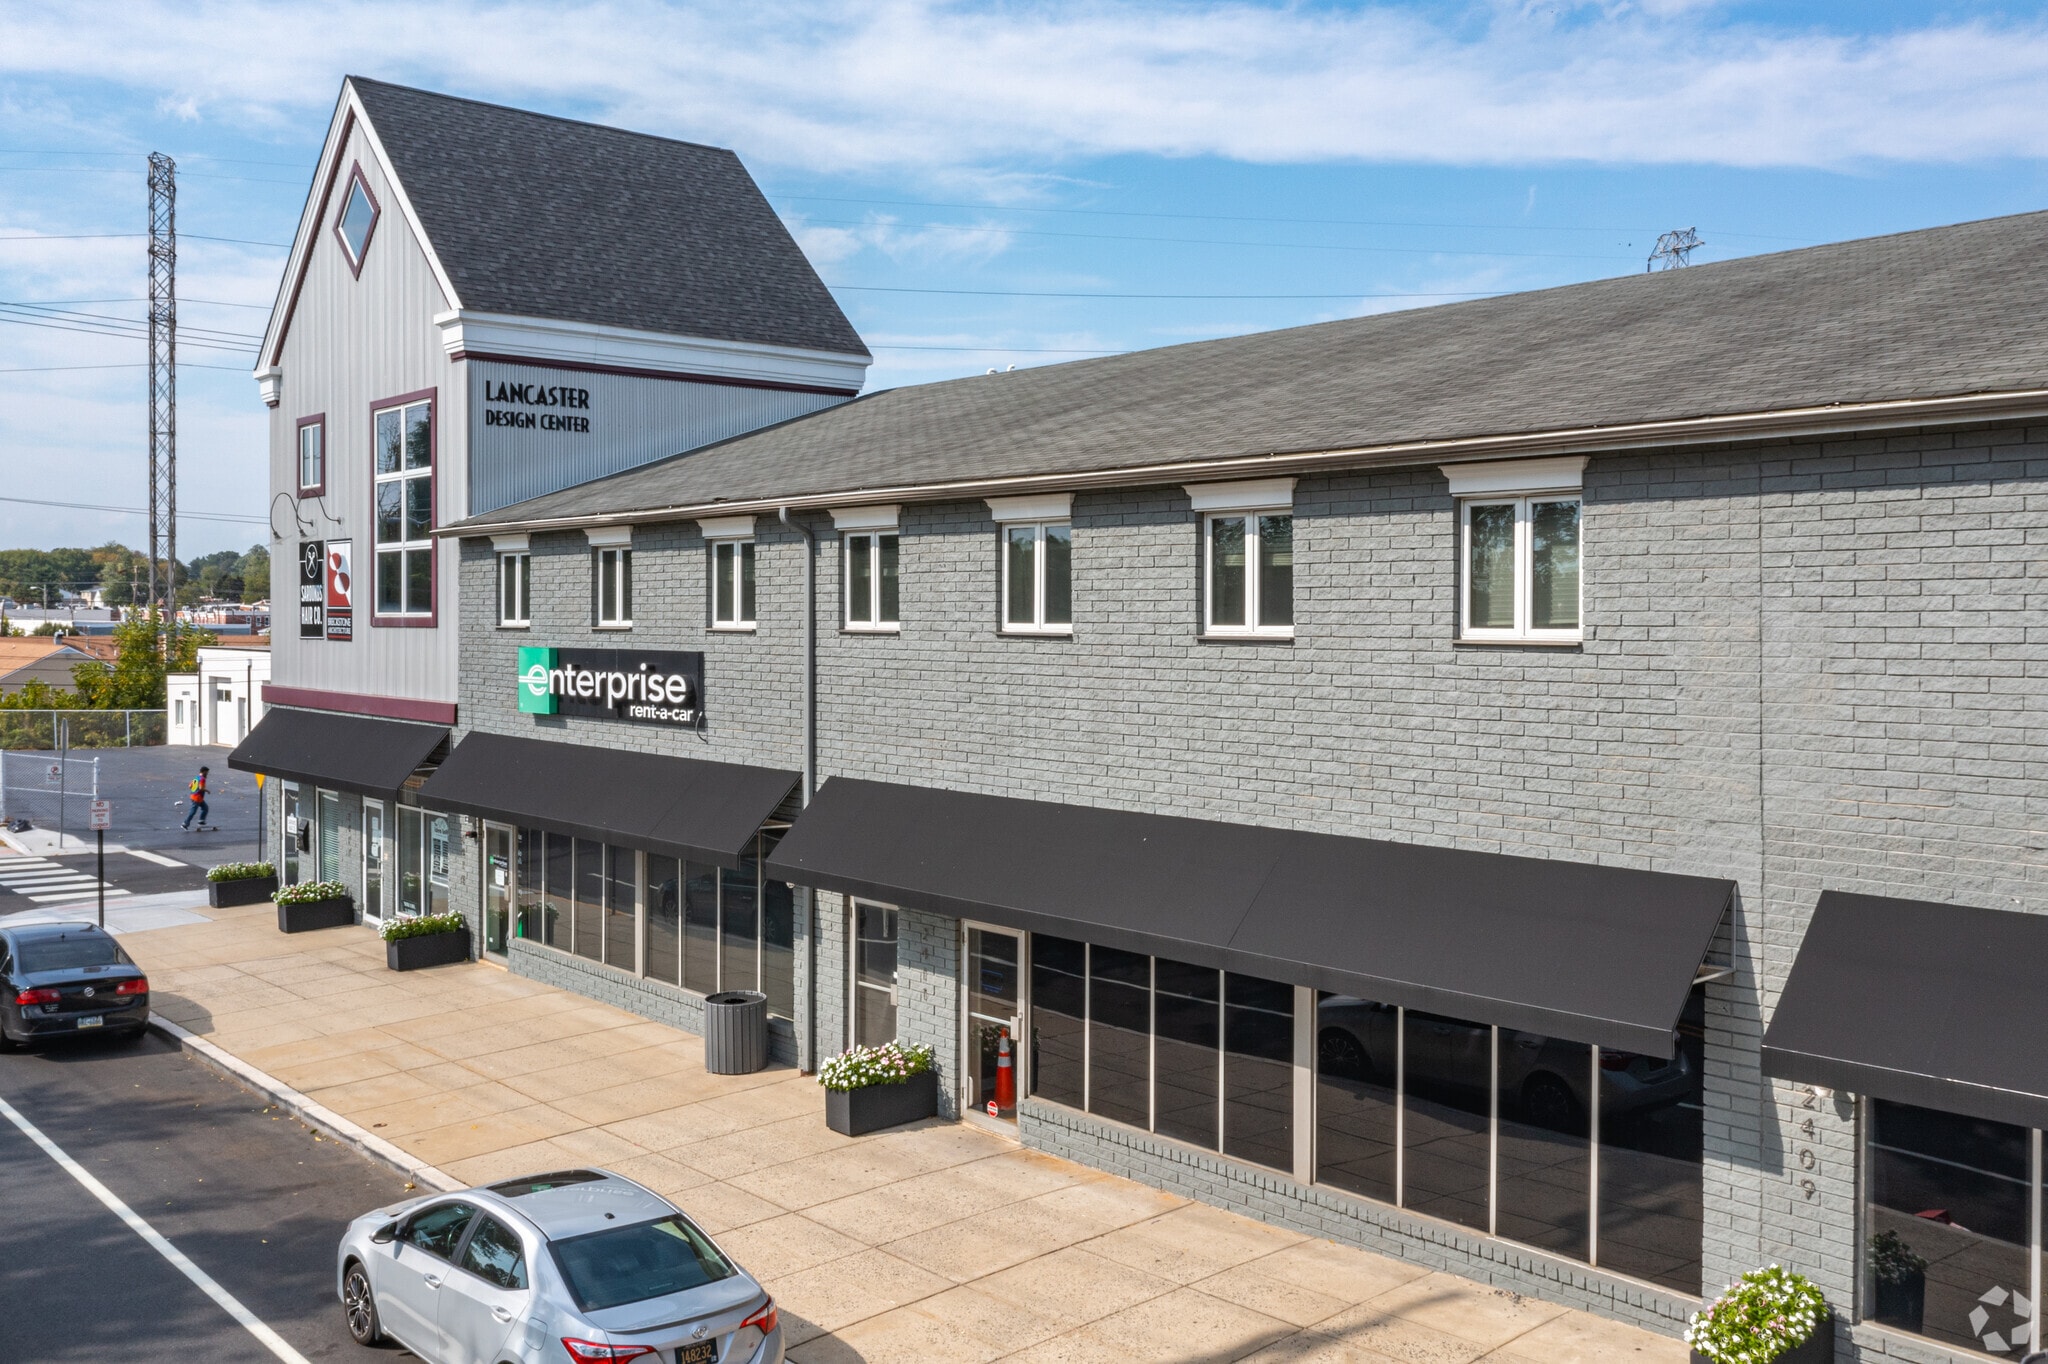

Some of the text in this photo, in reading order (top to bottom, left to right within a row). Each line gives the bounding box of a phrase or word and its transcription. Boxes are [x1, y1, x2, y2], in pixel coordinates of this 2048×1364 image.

[486, 380, 589, 409] LANCASTER
[486, 409, 589, 433] DESIGN CENTER
[301, 606, 313, 625] HAIR
[519, 663, 687, 709] enterprise
[630, 705, 693, 722] rent-a-car
